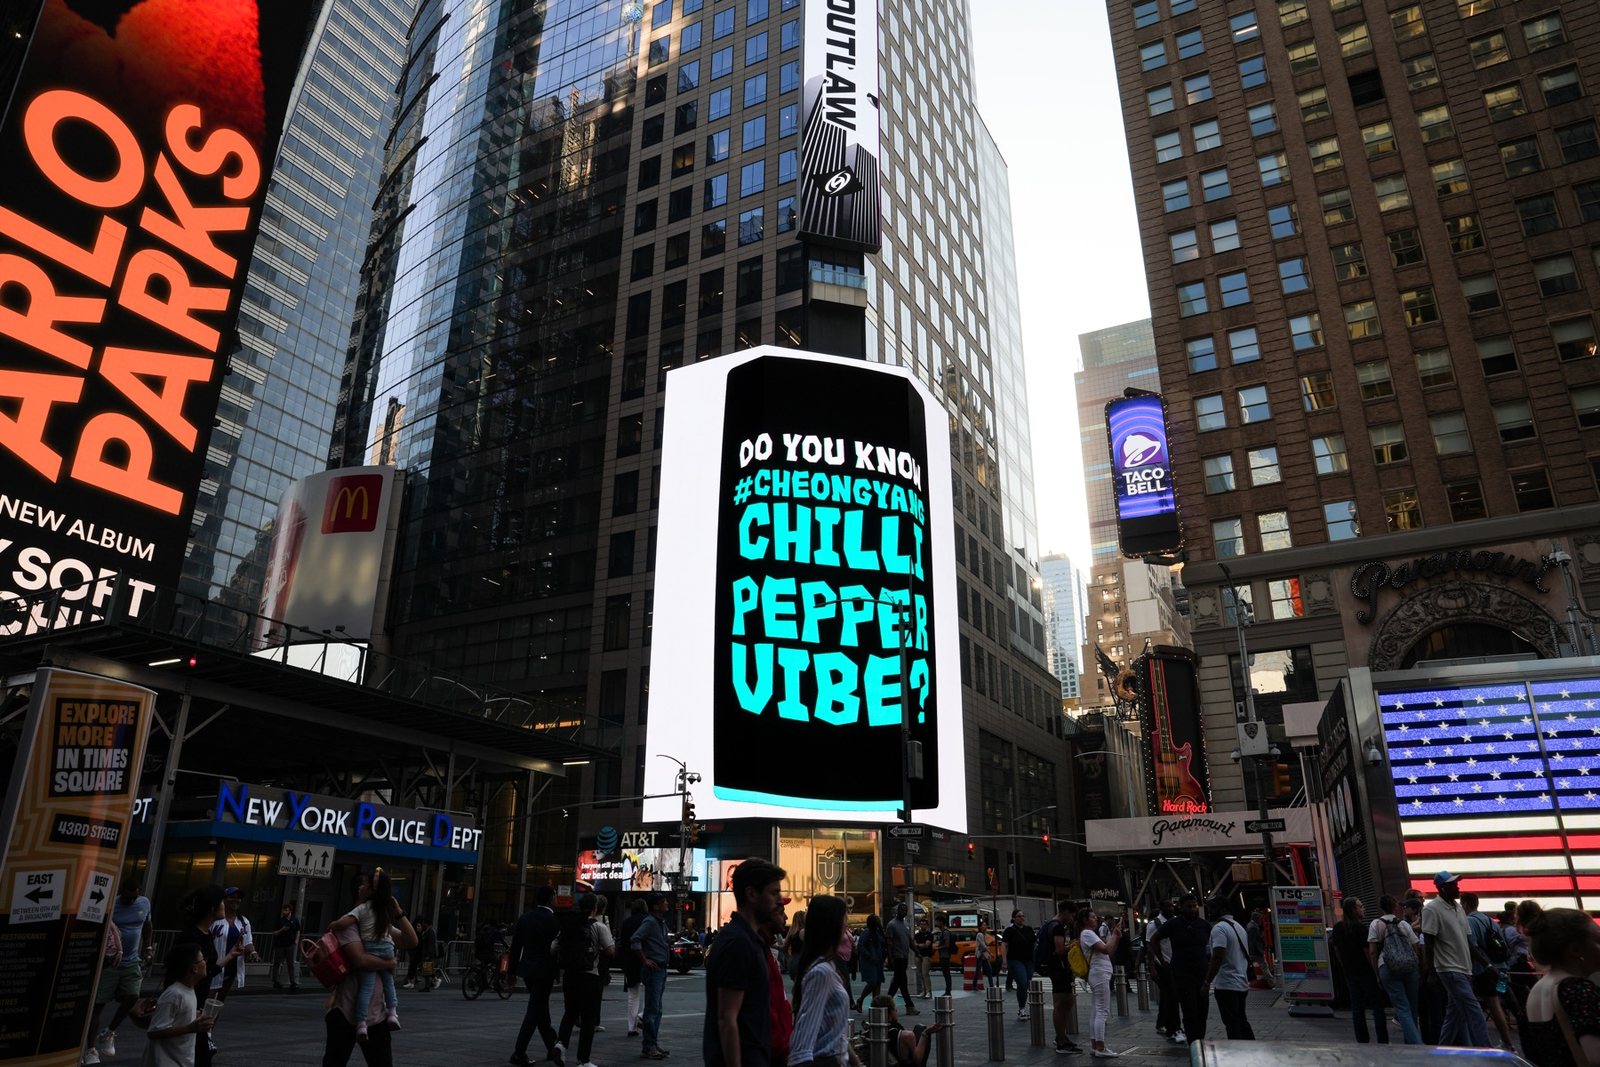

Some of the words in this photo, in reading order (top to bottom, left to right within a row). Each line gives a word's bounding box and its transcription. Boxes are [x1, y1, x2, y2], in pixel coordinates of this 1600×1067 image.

[0, 90, 145, 483] ARLO
[71, 104, 261, 515] PARKS
[739, 432, 773, 469] DO
[782, 433, 845, 466] YOU
[854, 441, 922, 492] KNOW
[1122, 467, 1165, 485] TACO
[733, 469, 925, 526] #CHEONGYANG
[1127, 479, 1168, 496] BELL
[0, 494, 66, 532] NEW
[66, 518, 156, 562] ALBUM
[739, 502, 925, 583] CHILLI
[12, 546, 156, 618] SOFT
[731, 574, 929, 652] PEPPER
[731, 641, 929, 727] VIBE?
[61, 702, 136, 725] EXPLORE
[58, 726, 113, 746] MORE
[56, 748, 79, 769] IN
[83, 748, 129, 769] TIMES
[54, 770, 124, 793] SQUARE
[216, 780, 283, 826] NEW
[285, 790, 351, 836] YORK
[354, 801, 426, 845] POLICE
[431, 812, 482, 851] DEPT
[1163, 799, 1185, 813] Hard
[1186, 799, 1207, 814] Rock
[58, 820, 89, 838] 43RD
[90, 824, 119, 842] STREET
[1152, 817, 1236, 846] Paramount
[1268, 821, 1281, 829] WAY
[620, 831, 659, 848] AT&T
[281, 865, 297, 873] ONLY
[298, 866, 314, 875] ONLY
[314, 868, 330, 877] ONLY
[580, 872, 591, 880] our
[592, 870, 608, 879] best
[612, 862, 624, 870] gets
[27, 873, 54, 886] EAST
[94, 875, 109, 888] WEST
[1278, 889, 1302, 899] TSQ
